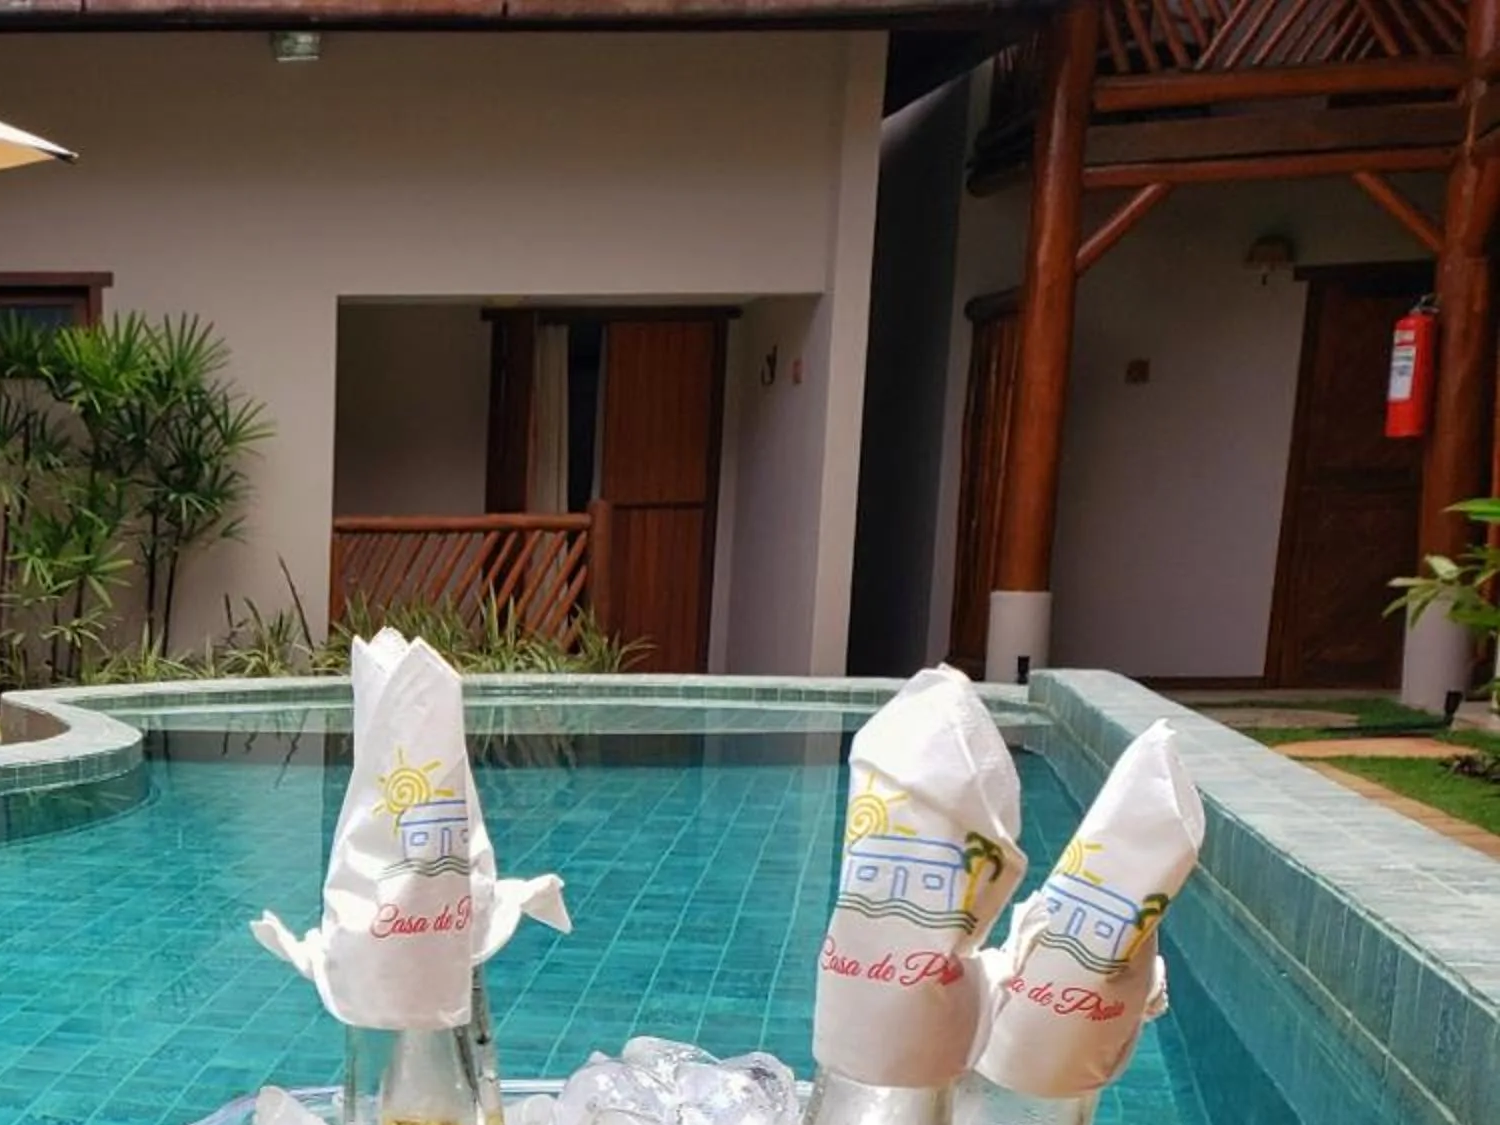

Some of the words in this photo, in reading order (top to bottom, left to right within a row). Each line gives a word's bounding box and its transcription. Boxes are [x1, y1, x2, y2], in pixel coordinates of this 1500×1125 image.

[370, 903, 430, 938] Casa
[433, 904, 453, 931] de
[867, 952, 896, 982] de
